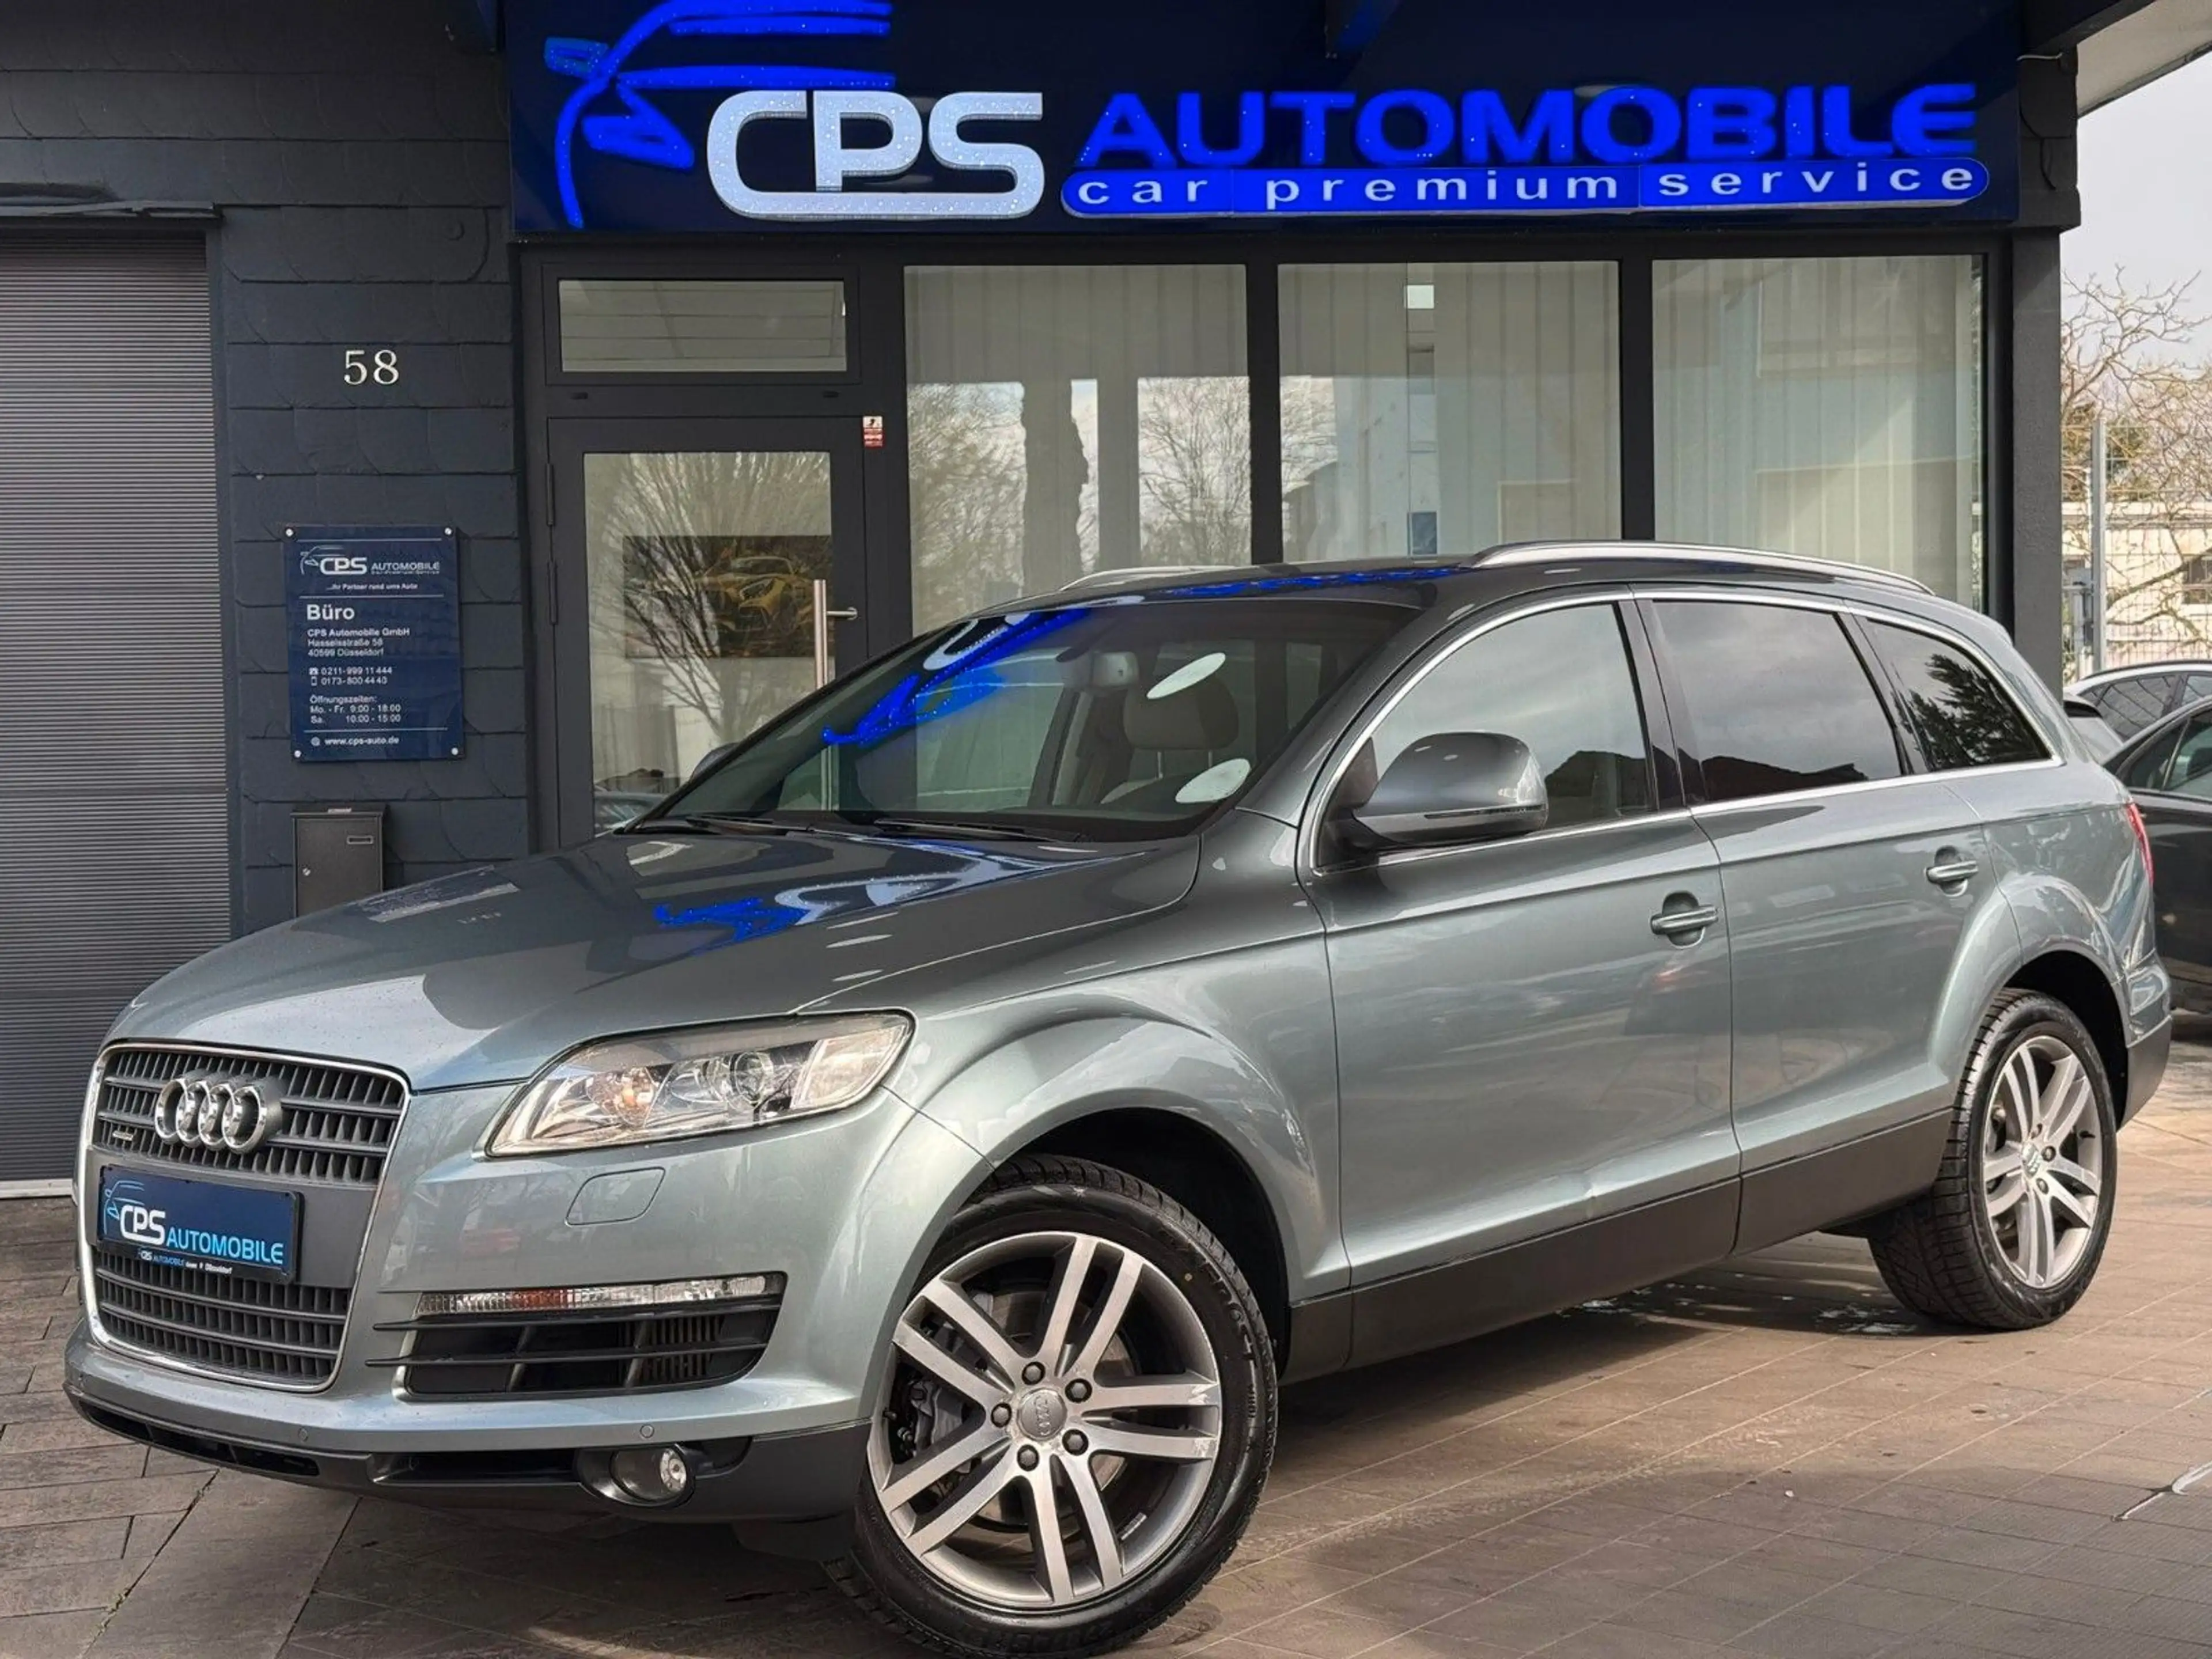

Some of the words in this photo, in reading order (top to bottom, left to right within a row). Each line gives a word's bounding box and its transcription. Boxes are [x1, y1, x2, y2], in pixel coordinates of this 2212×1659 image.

[706, 90, 1045, 219] CPS
[1075, 83, 1978, 168] AUTOMOBILE
[1078, 179, 1208, 204] car
[1266, 171, 1616, 210] premium
[1658, 162, 1974, 197] service
[344, 349, 399, 385] 58
[320, 557, 368, 575] CPS
[371, 562, 440, 571] AUTOMOBILE
[306, 604, 355, 620] Büro
[307, 628, 327, 637] CPS
[329, 628, 380, 637] Automobile
[382, 627, 410, 636] GmbH
[337, 647, 384, 657] Düsseldorf
[309, 694, 377, 704] Öffnungszeiten:
[324, 736, 400, 746] www.cps-auto.de
[120, 1204, 166, 1245] CPS
[166, 1227, 284, 1264] AUTOMOBILE
